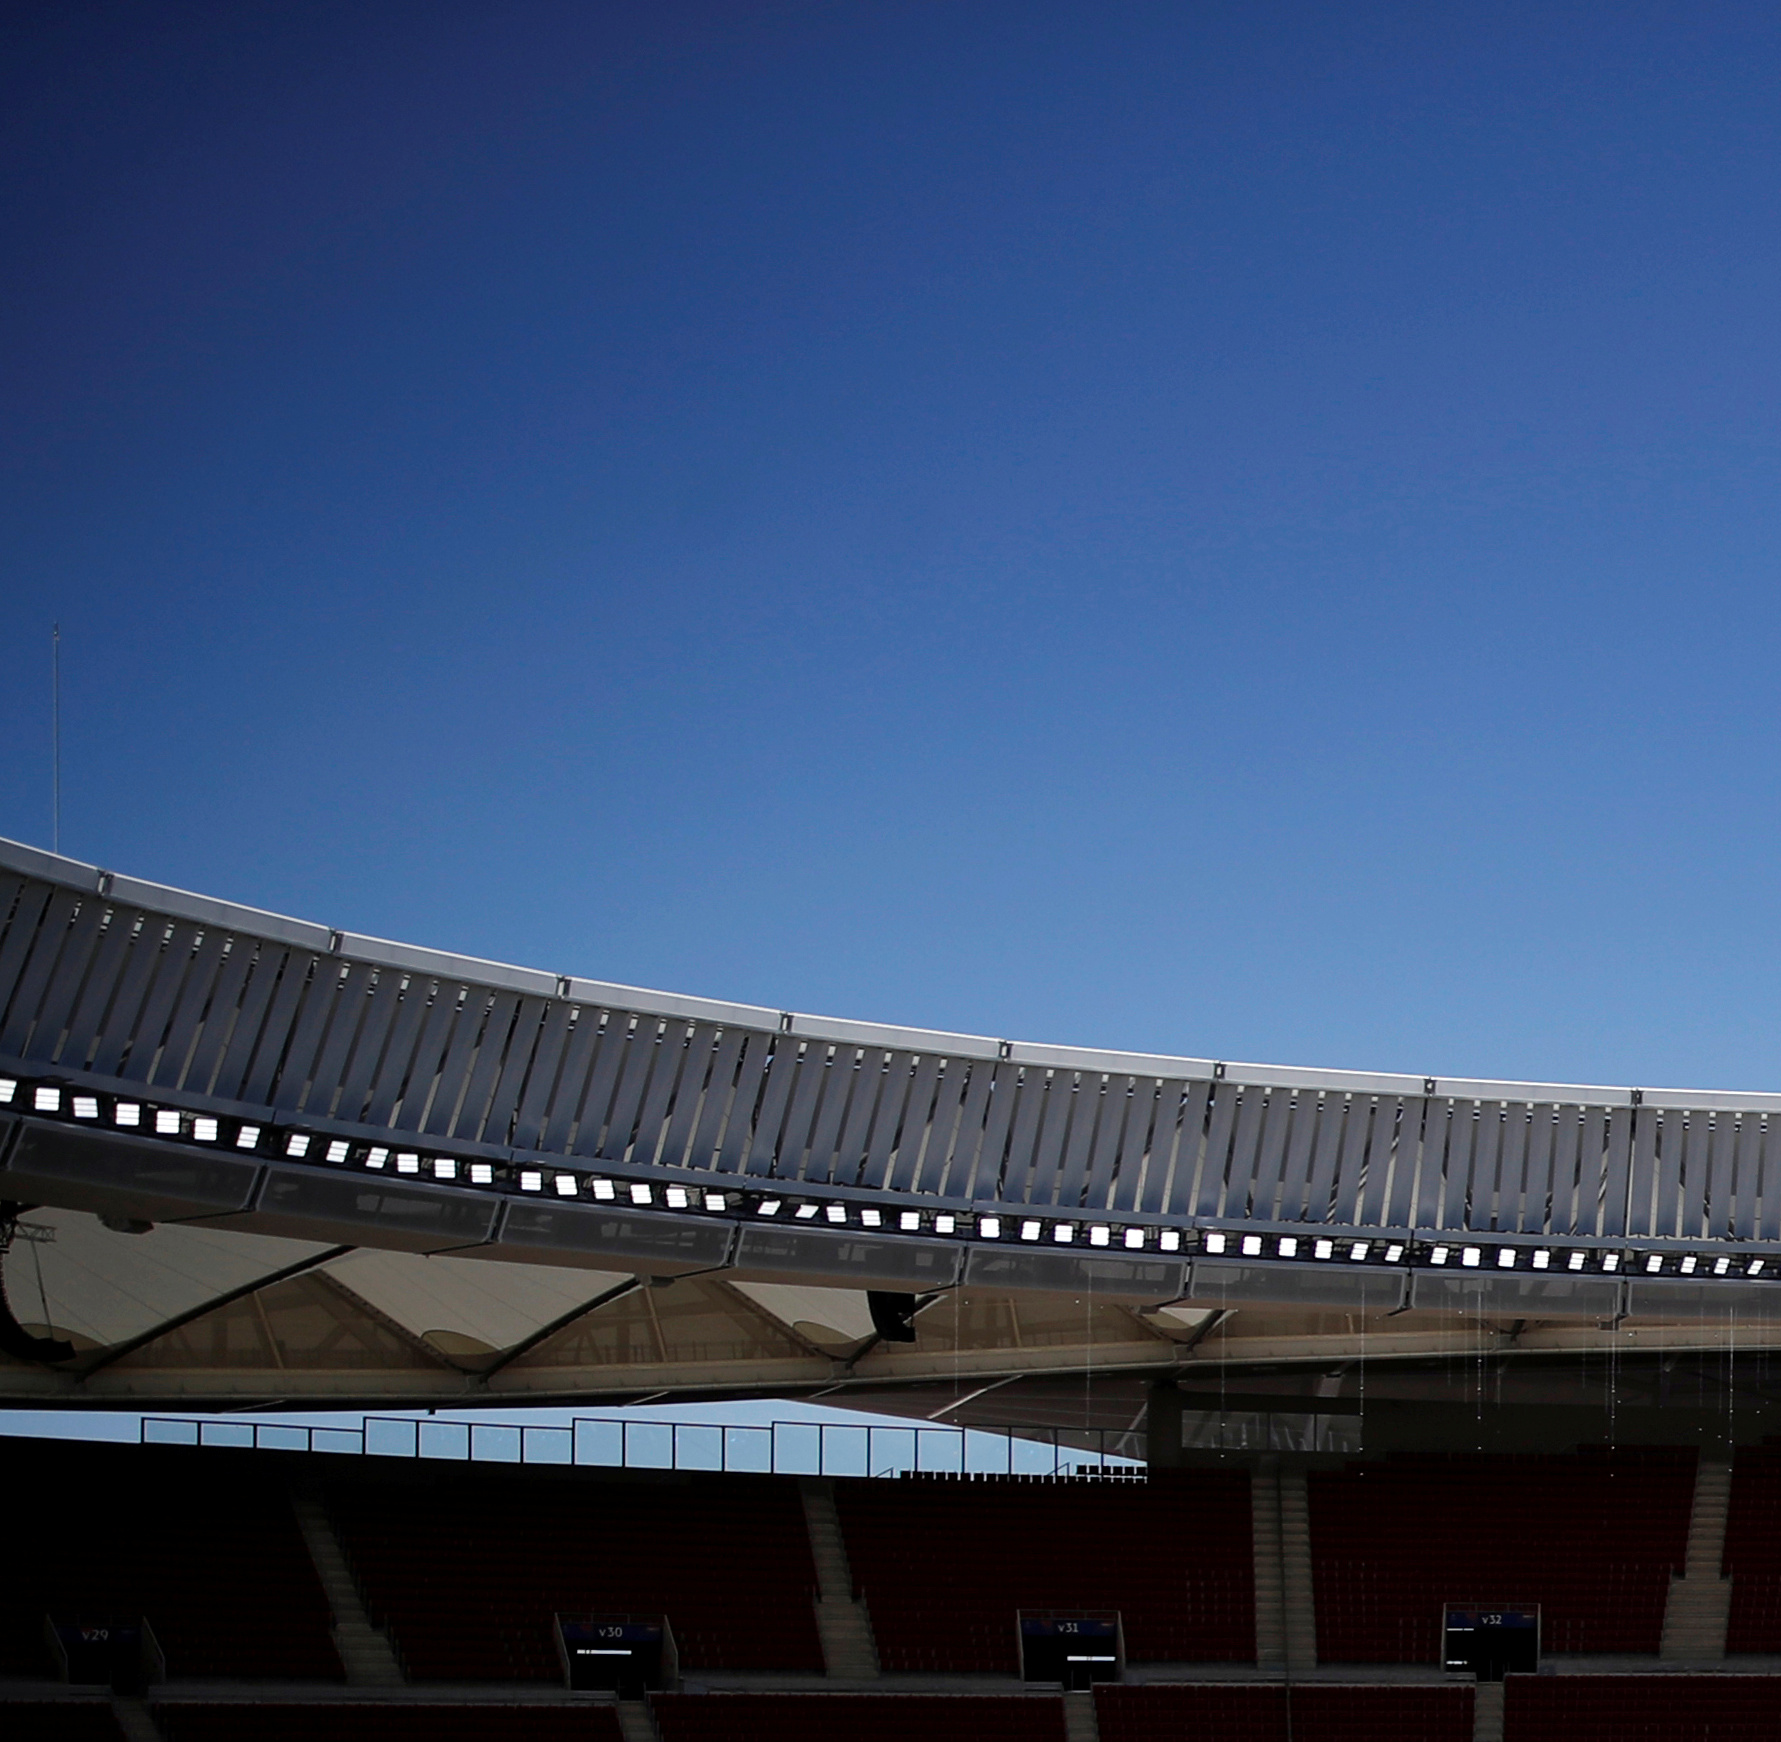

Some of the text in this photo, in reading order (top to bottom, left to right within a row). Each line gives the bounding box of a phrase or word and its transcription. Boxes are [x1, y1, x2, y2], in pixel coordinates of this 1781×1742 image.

[1481, 1614, 1503, 1625] v32
[597, 1627, 623, 1639] v30
[1056, 1622, 1080, 1634] v31
